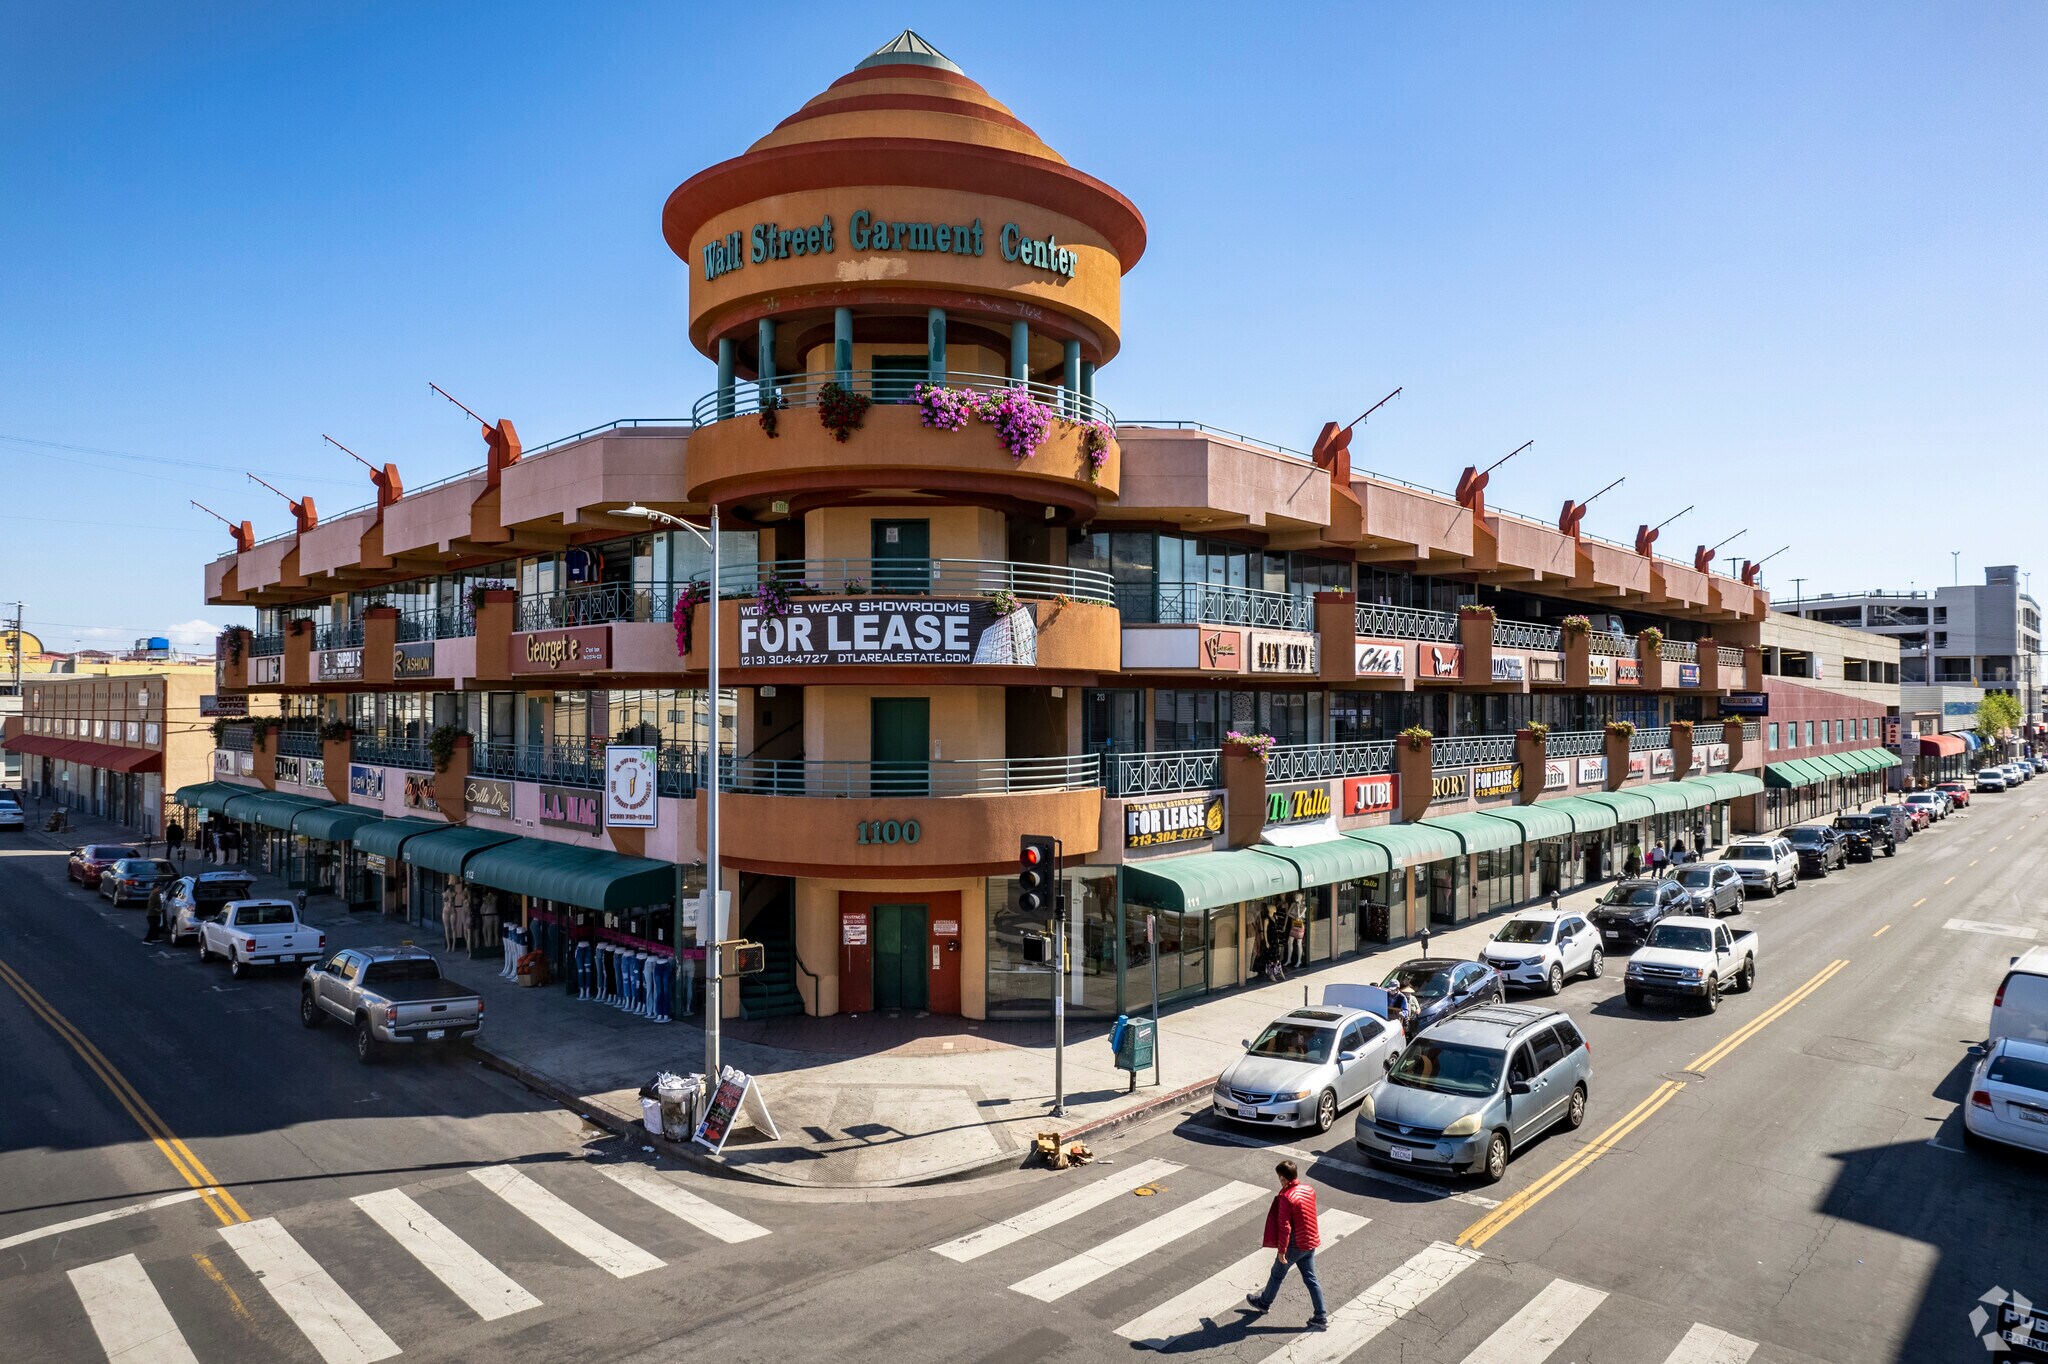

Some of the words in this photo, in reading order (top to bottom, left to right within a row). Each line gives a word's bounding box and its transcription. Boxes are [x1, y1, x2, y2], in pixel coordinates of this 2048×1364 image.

[702, 230, 742, 281] Wall
[751, 214, 835, 264] Street
[849, 209, 984, 257] Garment
[1000, 221, 1078, 278] Center
[808, 603, 853, 614] WEAR
[858, 601, 970, 613] SHOWROOMS
[741, 617, 814, 653] FOR
[828, 614, 970, 651] LEASE
[741, 656, 766, 666] (213)
[768, 654, 829, 664] 304-4727
[838, 653, 970, 663] DTLAREALESTATE.COM
[1262, 642, 1282, 664] KEY
[1289, 644, 1308, 665] KEY
[352, 776, 366, 790] new
[1475, 772, 1492, 789] FOR
[1492, 769, 1512, 787] LEASE
[465, 782, 490, 803] Bella
[1356, 781, 1392, 809] JUBI
[566, 795, 597, 826] MAG
[1128, 803, 1147, 812] DTLA
[1148, 801, 1165, 811] REAL
[1166, 797, 1204, 809] ESTATE.COM
[1269, 792, 1289, 821] Tu
[1294, 788, 1330, 818] Talla
[1128, 810, 1161, 836] FOR
[1164, 804, 1205, 832] LEASE
[857, 820, 921, 845] 1100
[1129, 826, 1205, 847] 213-304-4727
[1303, 874, 1315, 884] 110
[1187, 896, 1200, 908] 111
